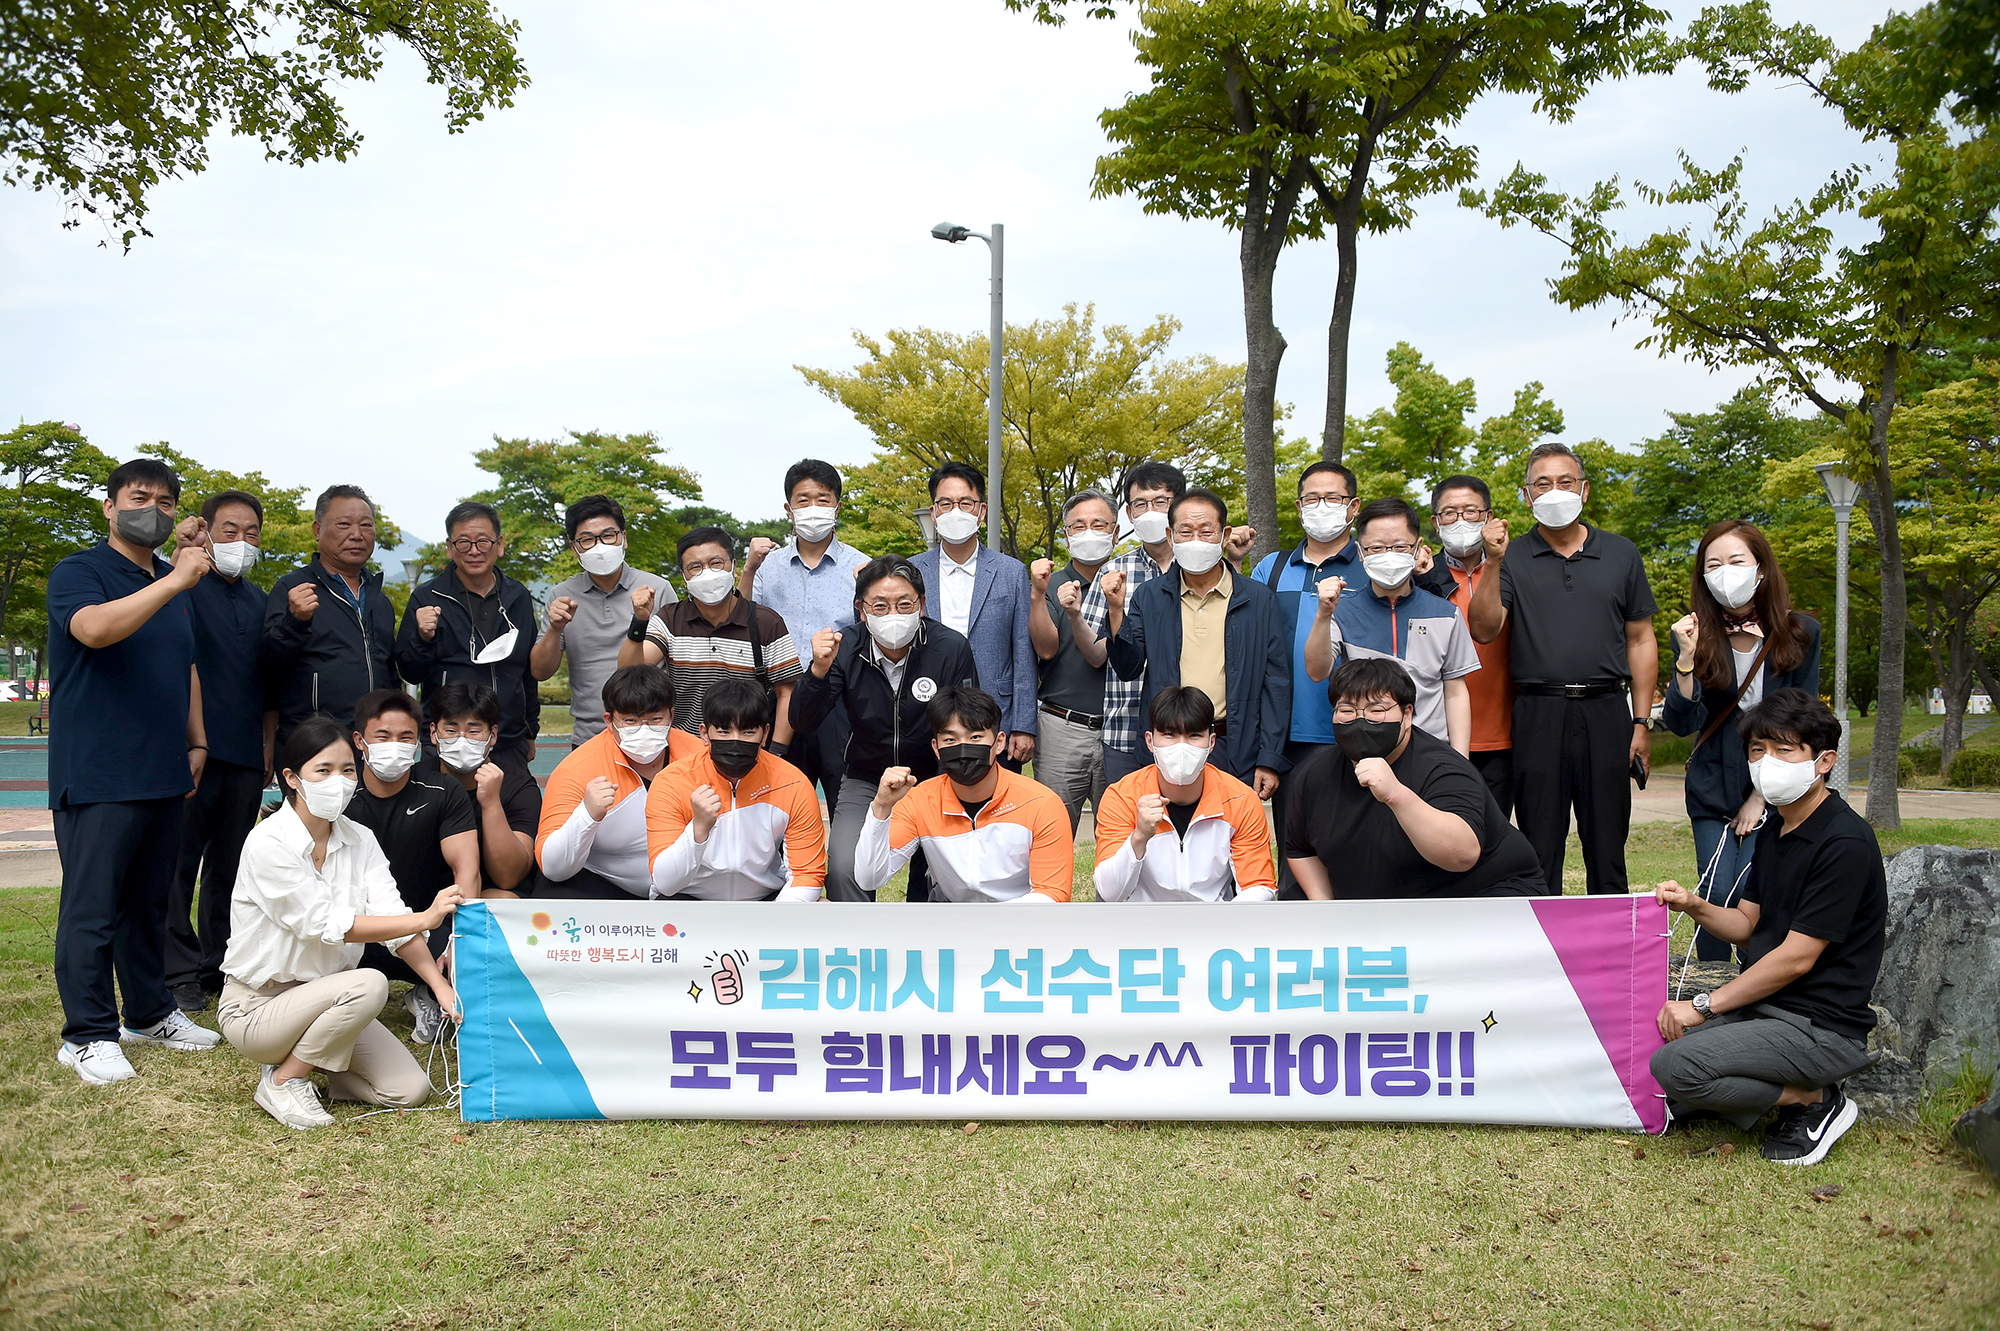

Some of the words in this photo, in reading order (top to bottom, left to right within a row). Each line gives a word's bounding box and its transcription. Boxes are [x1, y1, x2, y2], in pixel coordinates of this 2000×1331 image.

[562, 917, 595, 943] 꿈이
[599, 924, 656, 937] 이루어지는
[547, 950, 582, 962] 따뜻한
[587, 947, 644, 963] 행복도시
[650, 948, 678, 963] 김해
[758, 947, 955, 1013] 김해시
[980, 947, 1186, 1014] 선수단
[1208, 946, 1429, 1014] 여러분,
[670, 1030, 798, 1093] 모두
[1229, 1031, 1476, 1097] 파이팅!!
